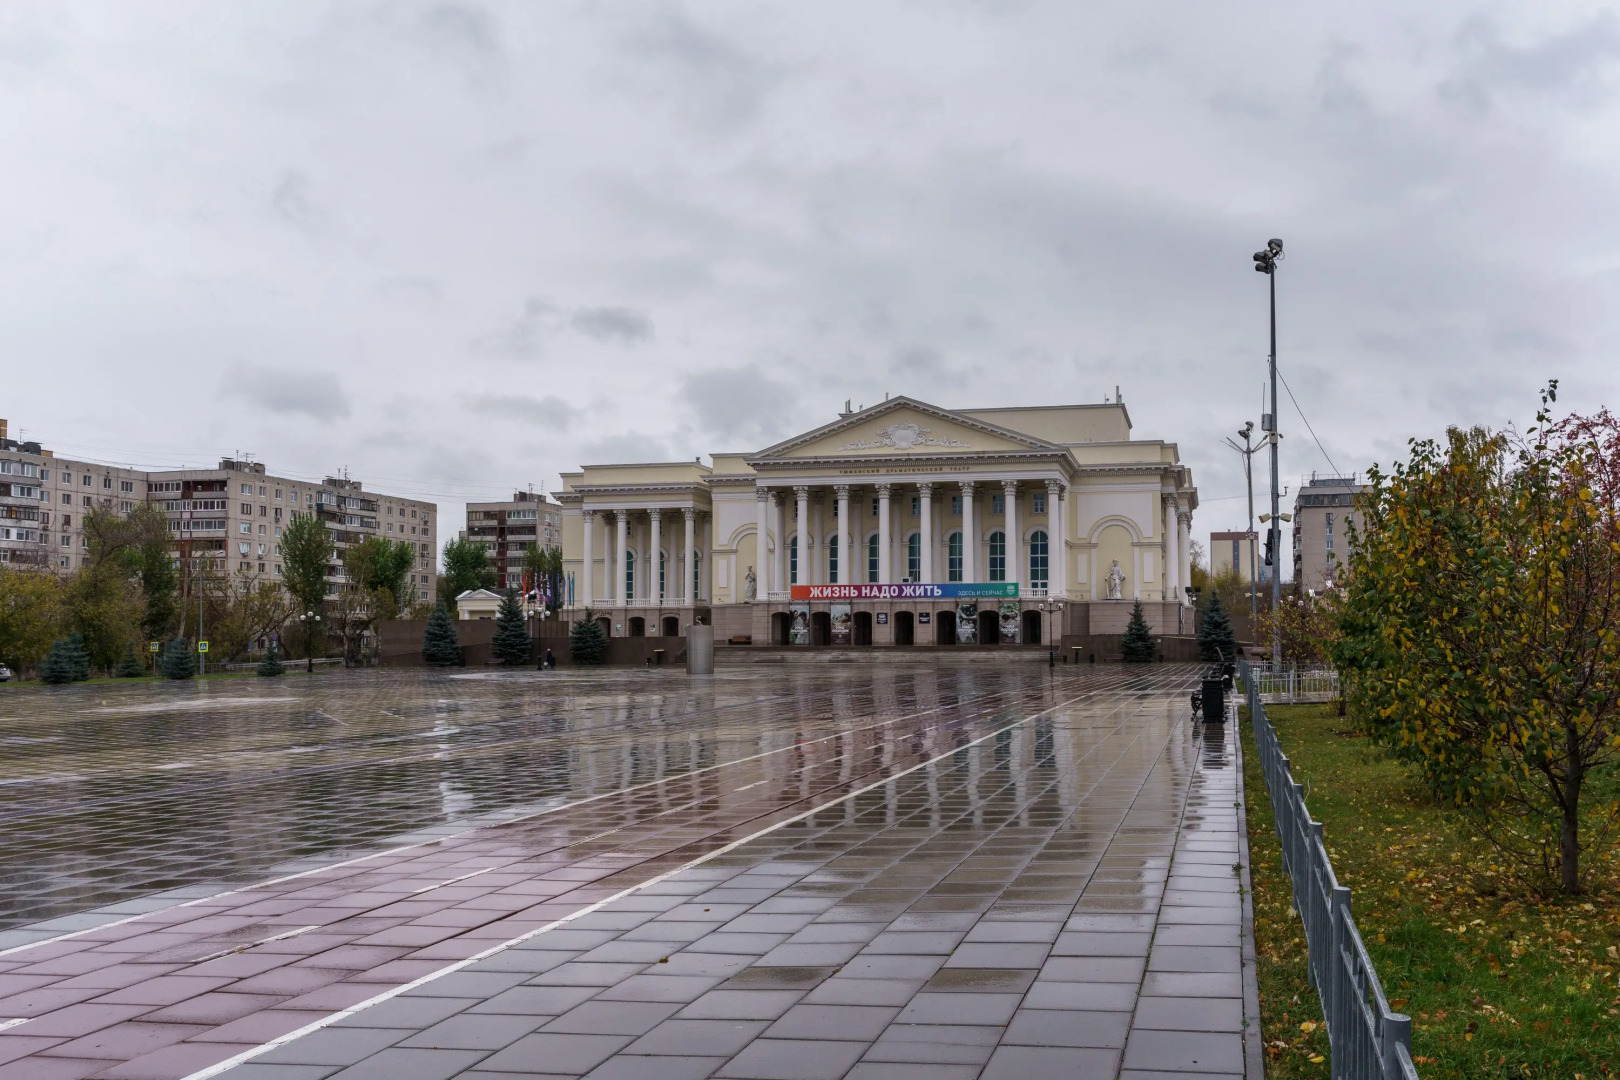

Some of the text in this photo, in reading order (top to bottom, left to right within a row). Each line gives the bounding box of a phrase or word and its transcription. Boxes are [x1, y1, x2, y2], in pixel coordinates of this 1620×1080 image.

[810, 585, 942, 598] ЖИЗНЬ НАДО ЖИТЬ
